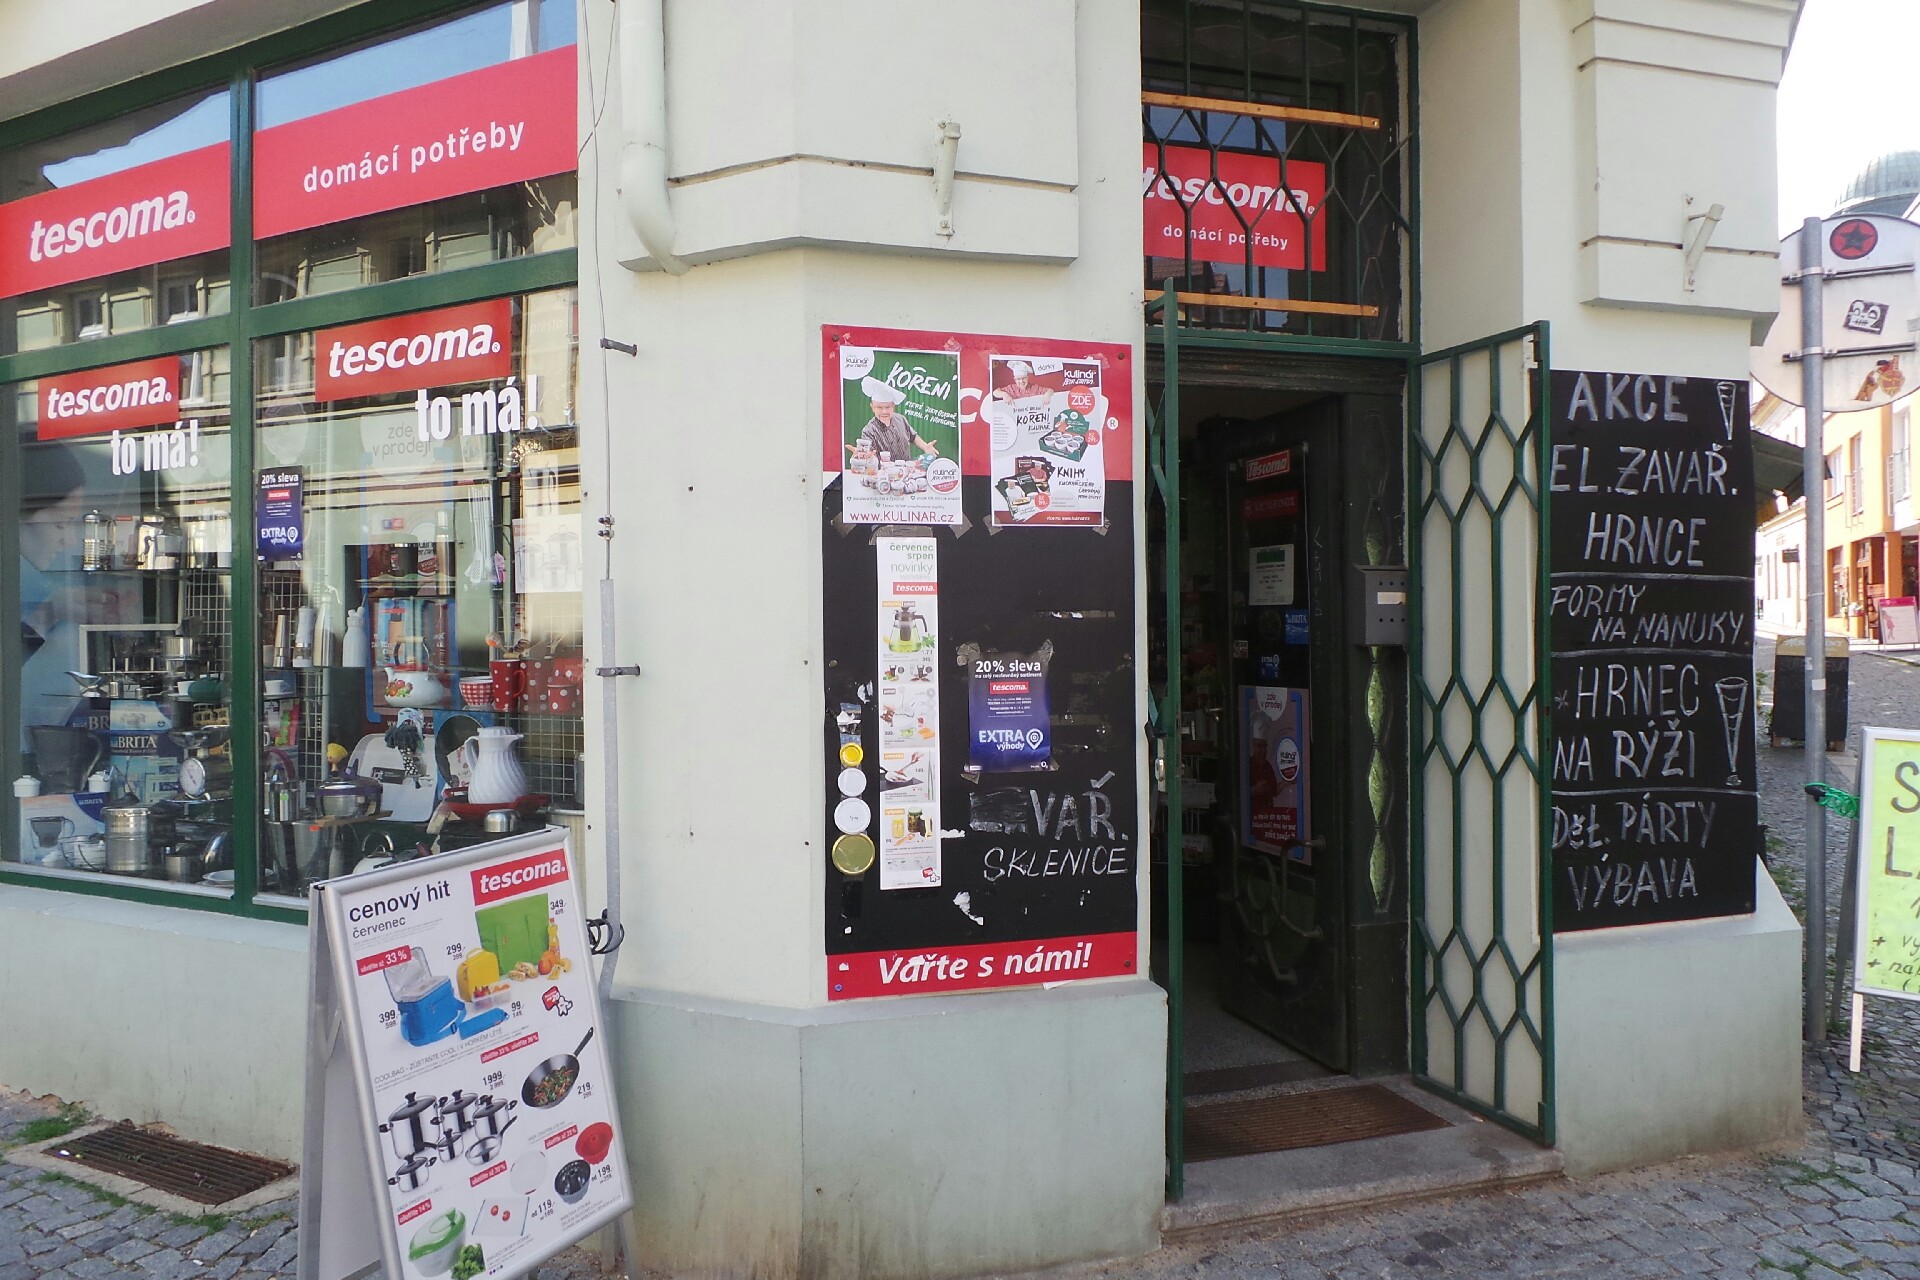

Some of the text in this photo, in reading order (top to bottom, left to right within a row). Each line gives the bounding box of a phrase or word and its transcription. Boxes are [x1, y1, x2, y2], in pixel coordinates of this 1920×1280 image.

[303, 121, 525, 193] domácí potřeby
[884, 361, 958, 400] KOŘENÍ
[415, 374, 539, 442] to má!
[1071, 395, 1092, 406] ZDE
[1567, 372, 1688, 423] AKCE
[388, 421, 413, 440] zde
[111, 419, 199, 476] to má!
[372, 445, 379, 456] v
[261, 472, 299, 485] 20% sleva
[1057, 466, 1086, 479] KNIHY
[849, 510, 955, 523] www.KULINAR.cz
[261, 527, 286, 538] EXTRA
[1584, 511, 1707, 567] HRNCE
[889, 542, 934, 552] červenec
[907, 552, 934, 561] srpen
[890, 562, 933, 575] novinky
[1550, 584, 1647, 618] FORMY
[1591, 609, 1744, 648] NA NANUKY
[975, 659, 1041, 673] 20% sleva
[1266, 693, 1276, 701] zde
[1575, 663, 1699, 719] HRNEC
[118, 736, 157, 748] BRITA
[979, 729, 1025, 743] EXTRA
[996, 741, 1025, 752] výhody
[1553, 718, 1695, 781] NA RÝŽI
[1615, 791, 1716, 848] PÁRTY
[983, 846, 1129, 882] SKLENICE
[1568, 852, 1699, 911] VÝBAVA
[349, 880, 451, 923] cenový hit
[352, 916, 406, 939] červenec
[385, 952, 397, 964] 33
[397, 950, 408, 961] %
[879, 942, 1093, 985] Vařte s námi!
